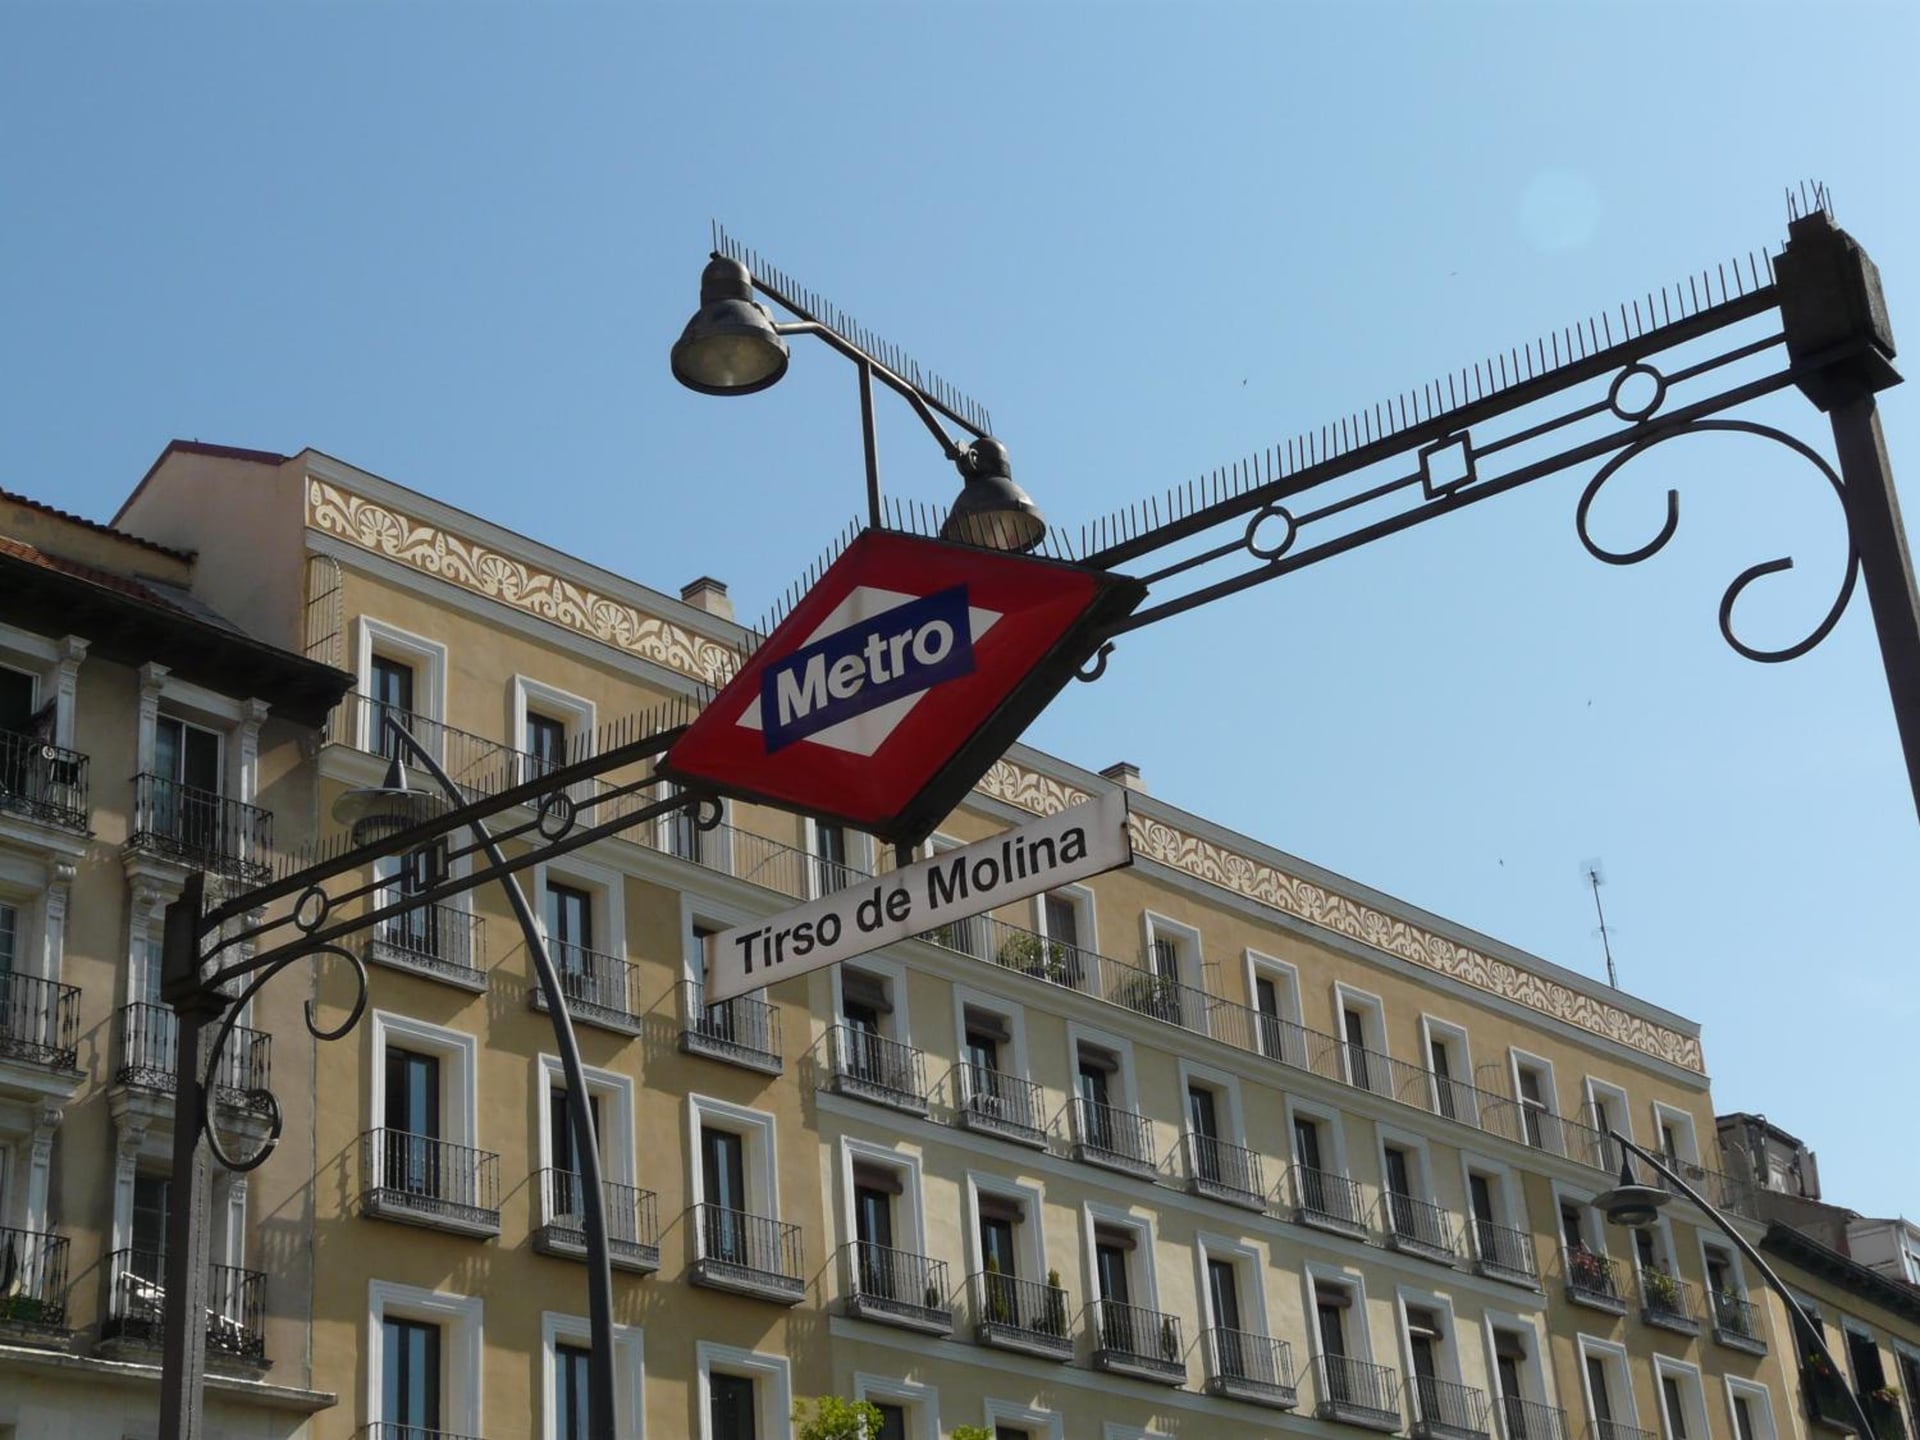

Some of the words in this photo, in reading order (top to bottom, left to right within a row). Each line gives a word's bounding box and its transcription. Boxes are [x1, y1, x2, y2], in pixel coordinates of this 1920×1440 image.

[776, 619, 954, 727] Metro
[735, 912, 842, 976] Tirso
[856, 886, 911, 933] de
[927, 826, 1088, 910] Molina
